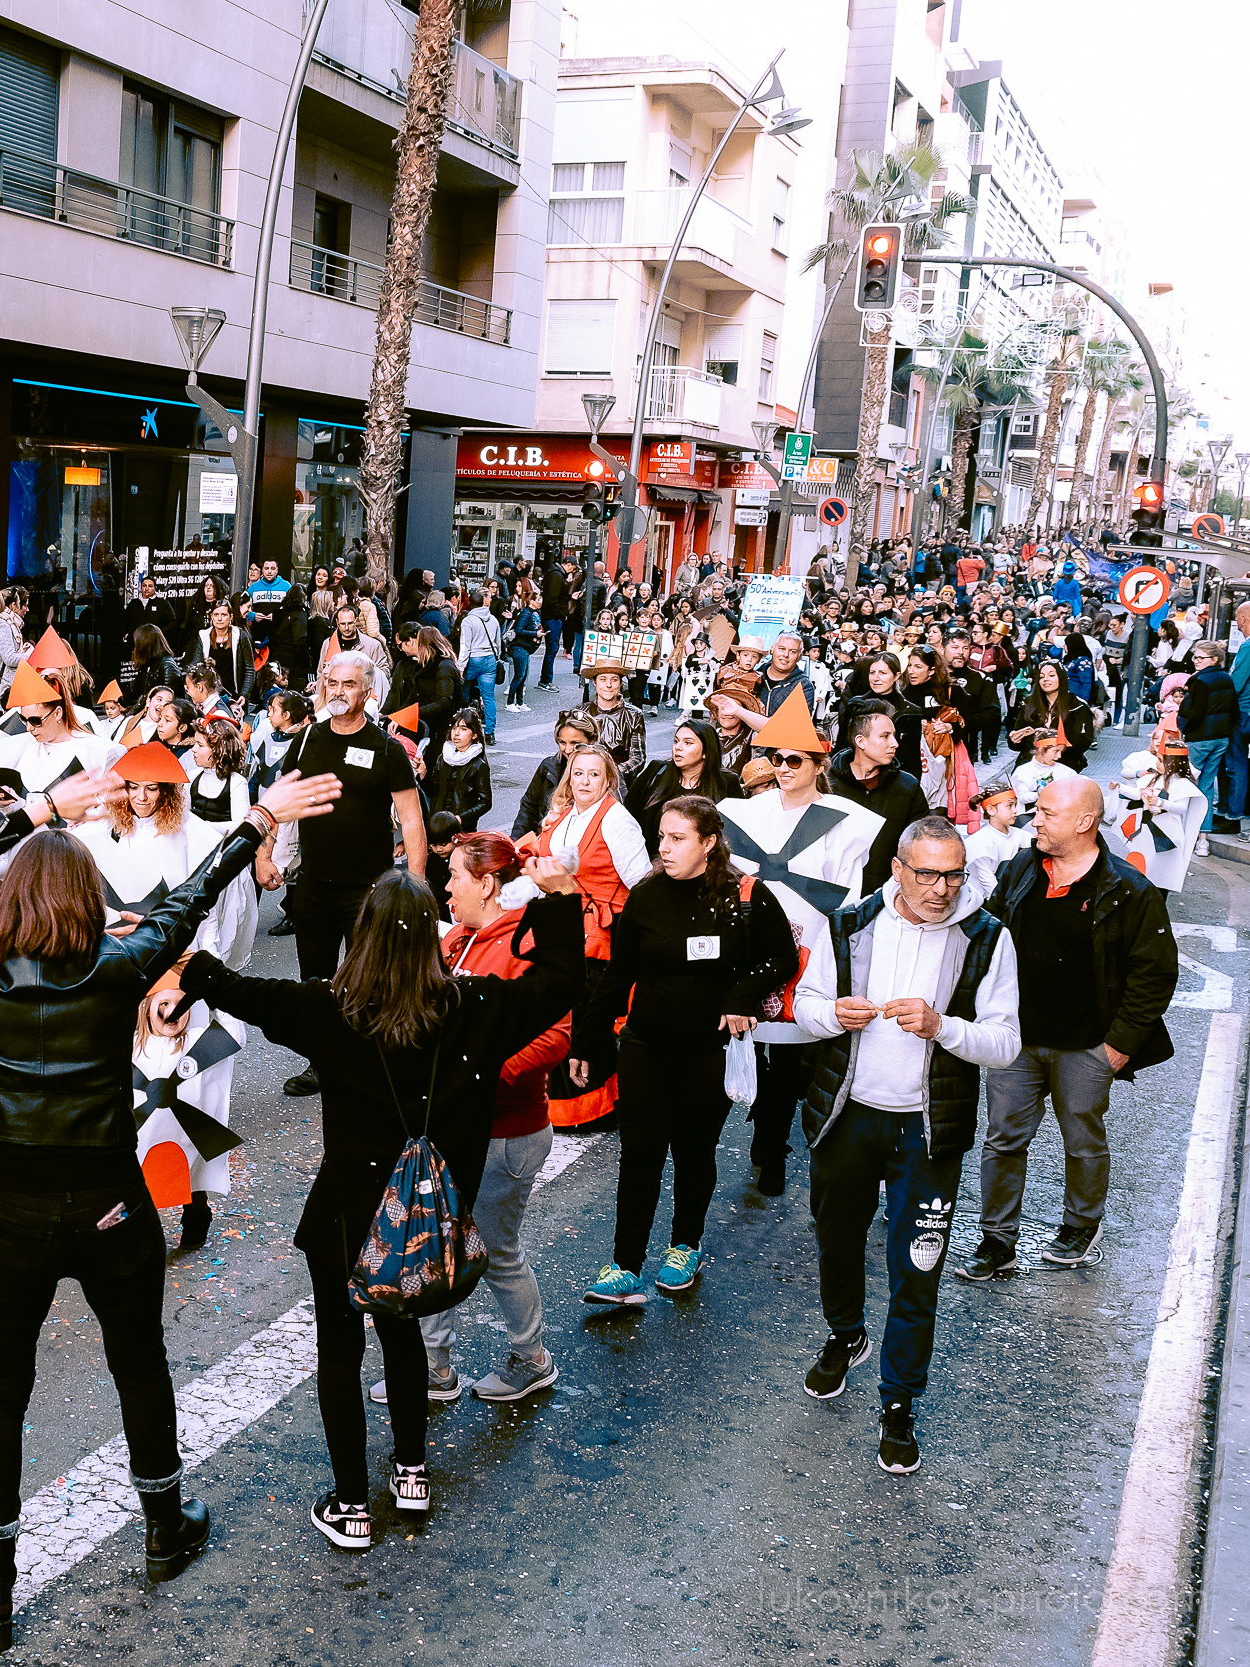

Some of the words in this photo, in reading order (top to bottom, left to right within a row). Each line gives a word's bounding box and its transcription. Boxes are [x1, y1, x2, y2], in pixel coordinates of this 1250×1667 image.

[480, 445, 550, 467] C.I.B.
[657, 443, 684, 458] C.I.B.
[454, 467, 486, 476] TÍCULOS
[487, 469, 497, 477] DE
[498, 469, 542, 478] PELUQUERÍA
[549, 470, 583, 479] ESTÉTICA
[731, 463, 768, 475] C.I.B.
[915, 1219, 948, 1229] adidas
[399, 1482, 427, 1498] NIKE
